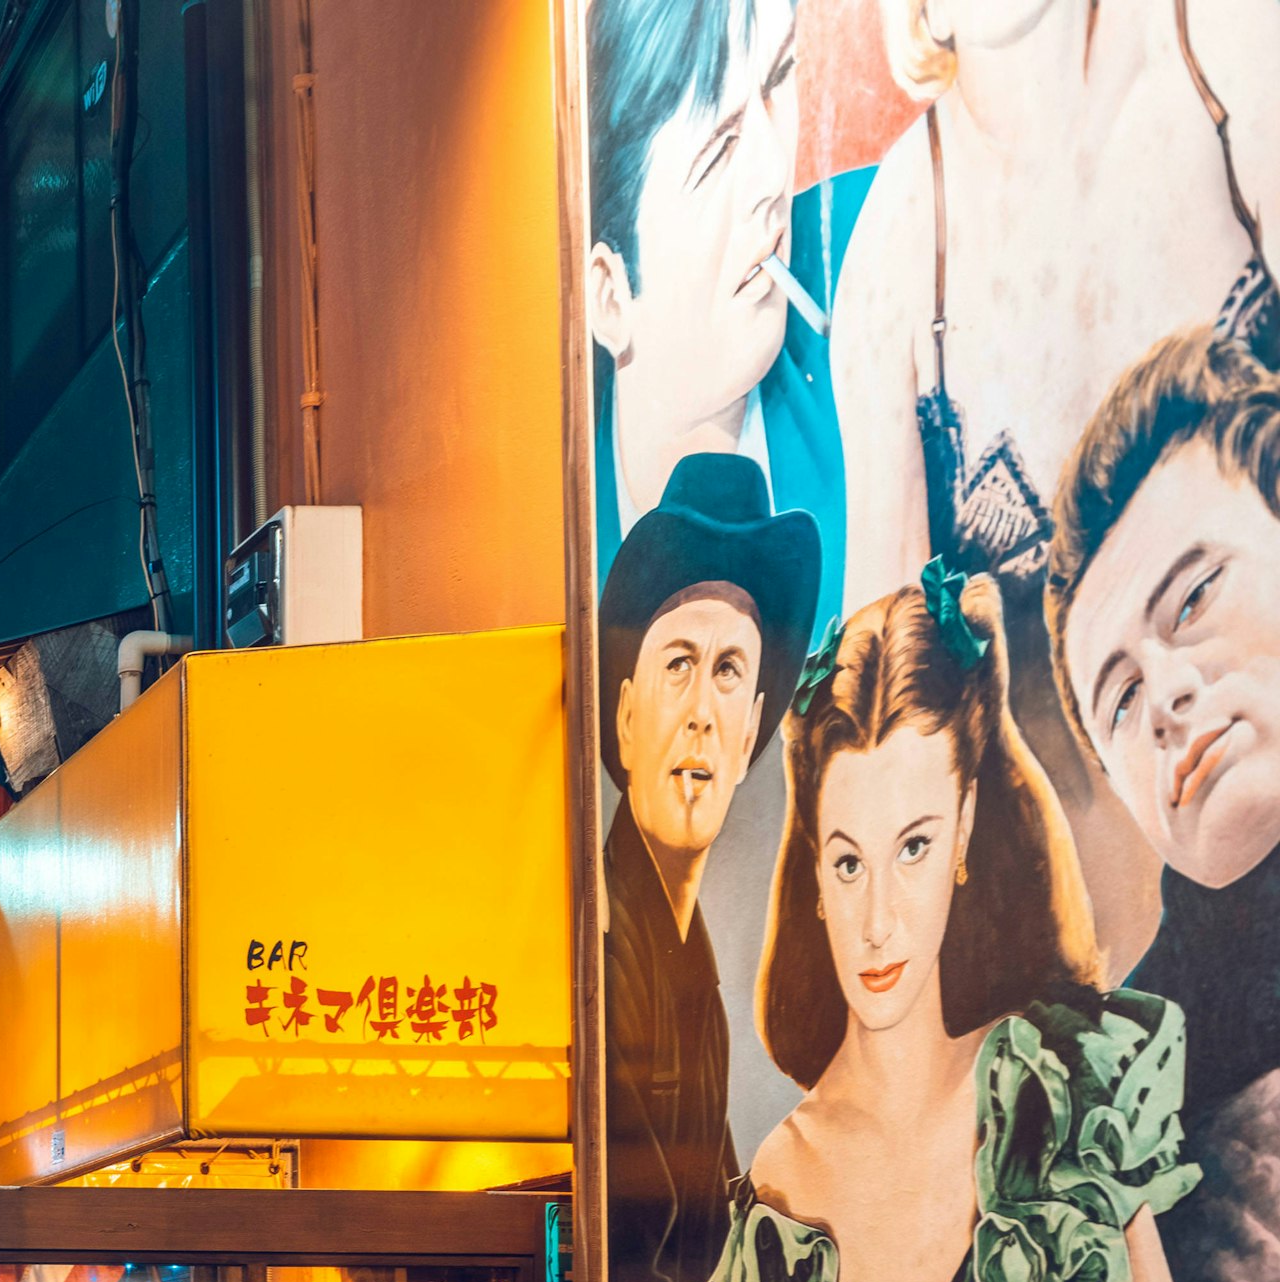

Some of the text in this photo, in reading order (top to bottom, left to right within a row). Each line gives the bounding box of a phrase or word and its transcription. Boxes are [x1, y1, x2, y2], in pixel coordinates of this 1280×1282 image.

[246, 940, 308, 971] BAR
[244, 975, 499, 1043] キネマ倶楽部
